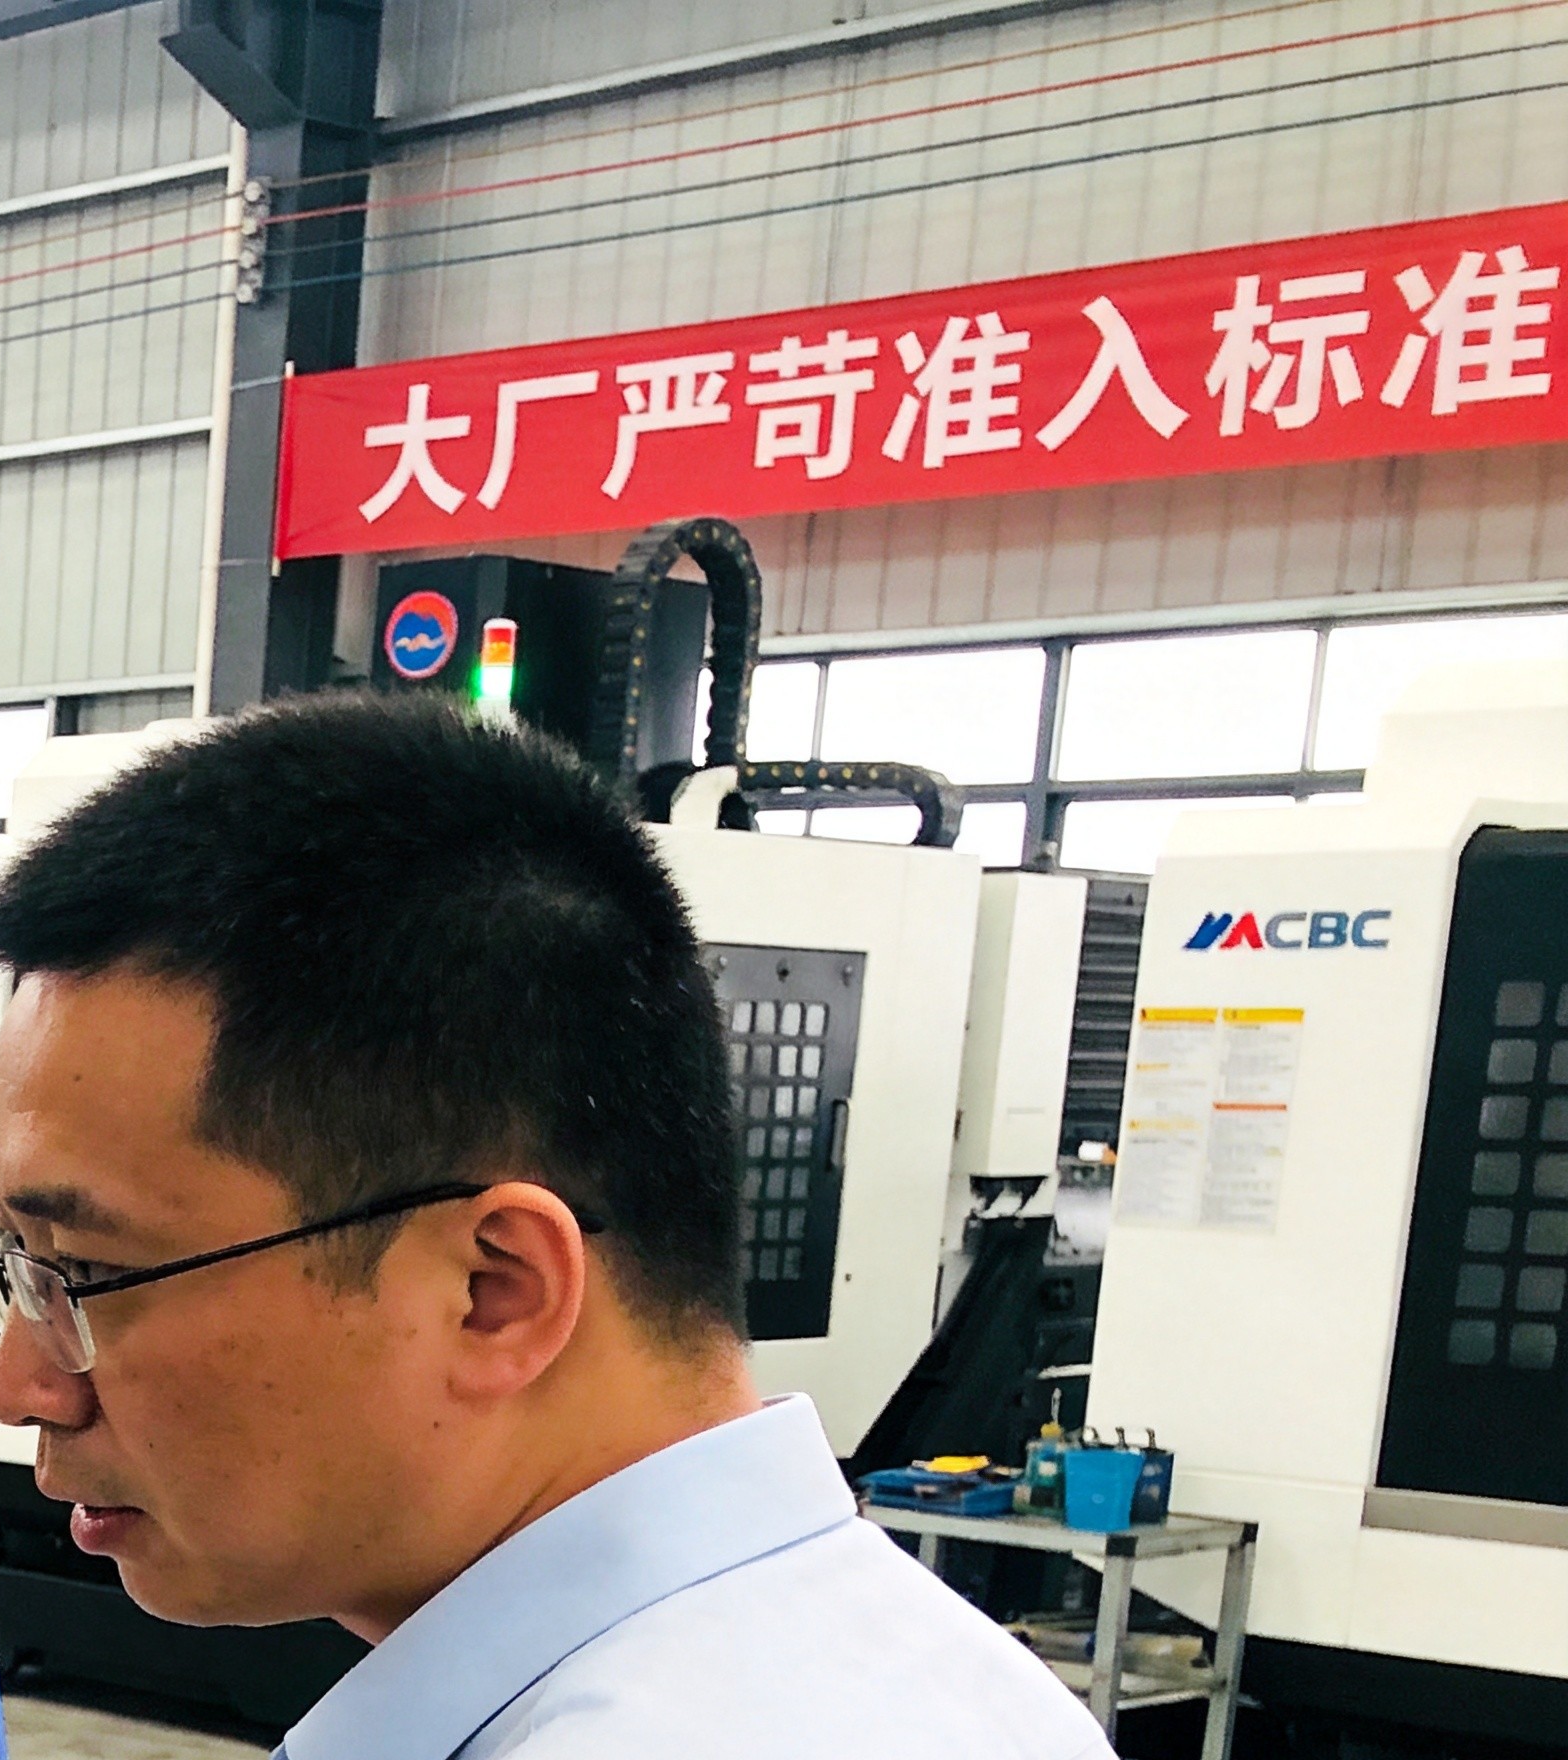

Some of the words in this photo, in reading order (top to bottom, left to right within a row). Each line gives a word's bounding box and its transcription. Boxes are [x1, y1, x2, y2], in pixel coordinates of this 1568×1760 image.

[360, 245, 1560, 523] 大厂严苛准入标准
